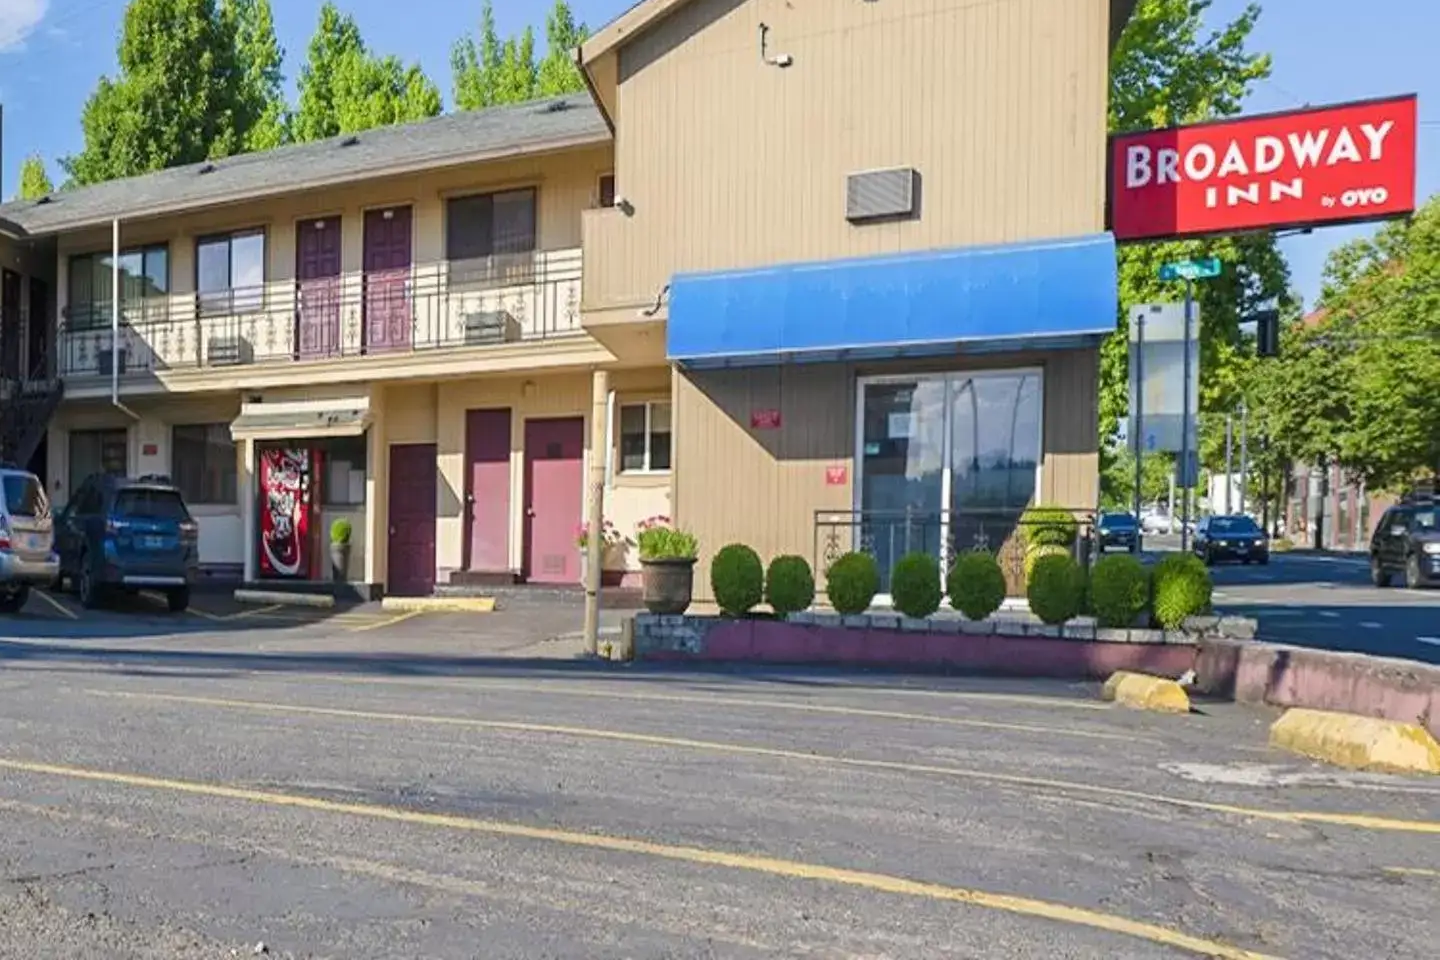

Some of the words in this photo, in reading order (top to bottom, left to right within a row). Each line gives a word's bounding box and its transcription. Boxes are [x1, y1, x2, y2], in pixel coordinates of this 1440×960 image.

[1126, 121, 1393, 188] BROADWAY
[1205, 178, 1303, 208] INN
[1340, 187, 1389, 208] OYO
